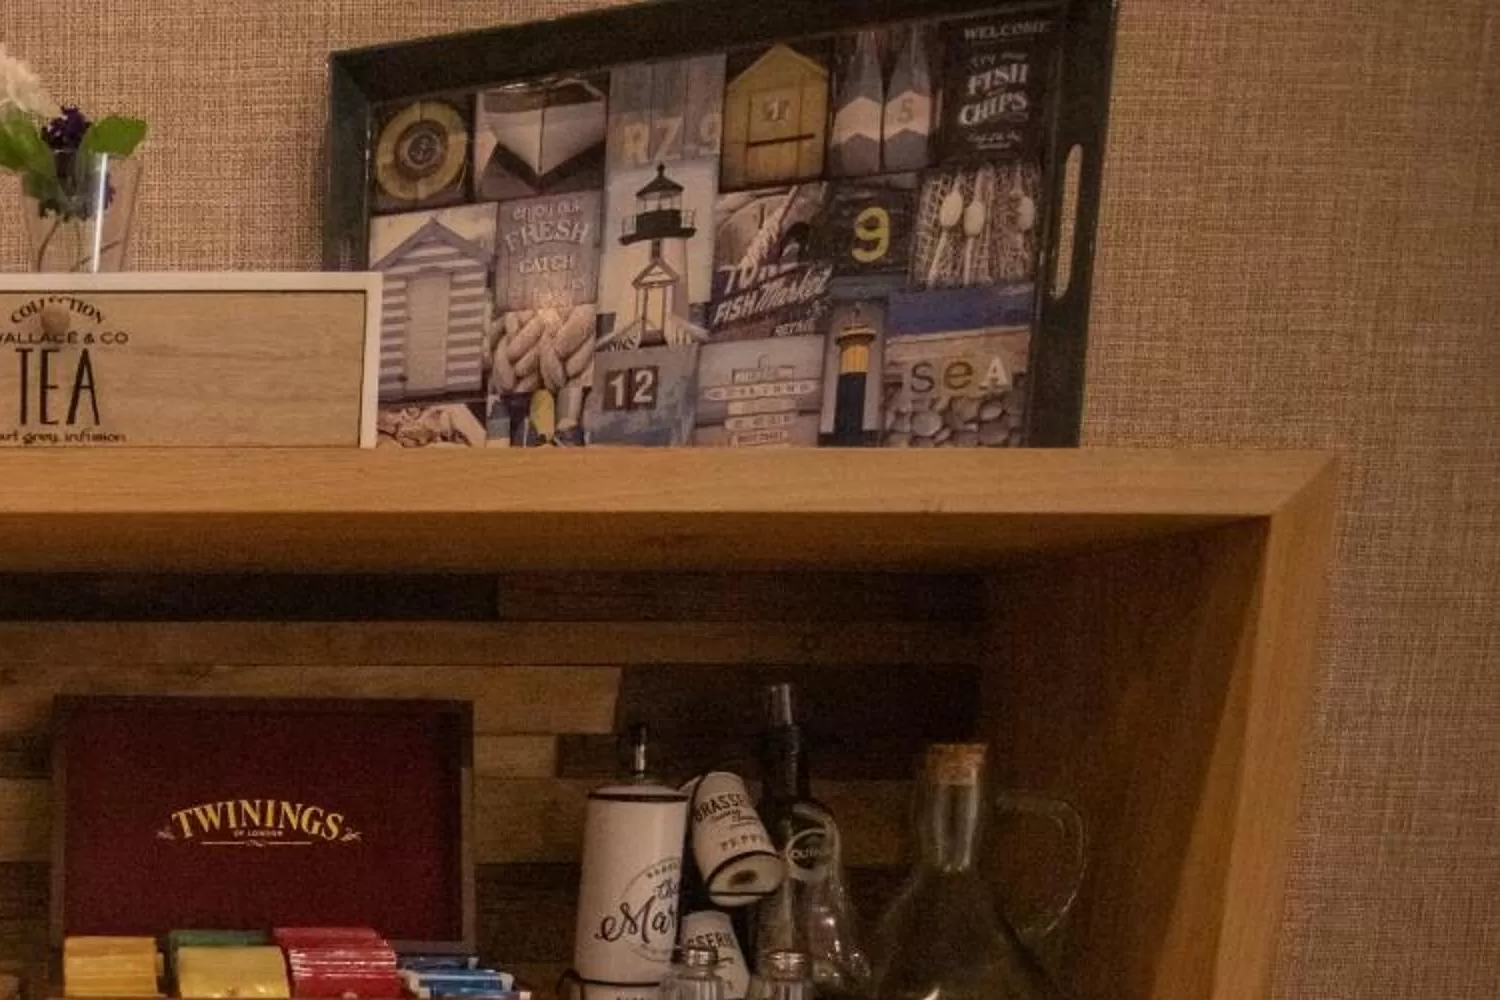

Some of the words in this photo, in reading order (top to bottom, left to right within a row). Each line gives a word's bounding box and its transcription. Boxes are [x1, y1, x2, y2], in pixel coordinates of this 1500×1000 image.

[967, 62, 1030, 96] FISH
[958, 89, 1030, 127] CHIPS
[851, 206, 890, 264] 9
[84, 332, 95, 344] &
[100, 331, 130, 345] CO
[15, 347, 101, 427] TEA
[610, 369, 654, 407] 12
[171, 798, 345, 841] TWININGS
